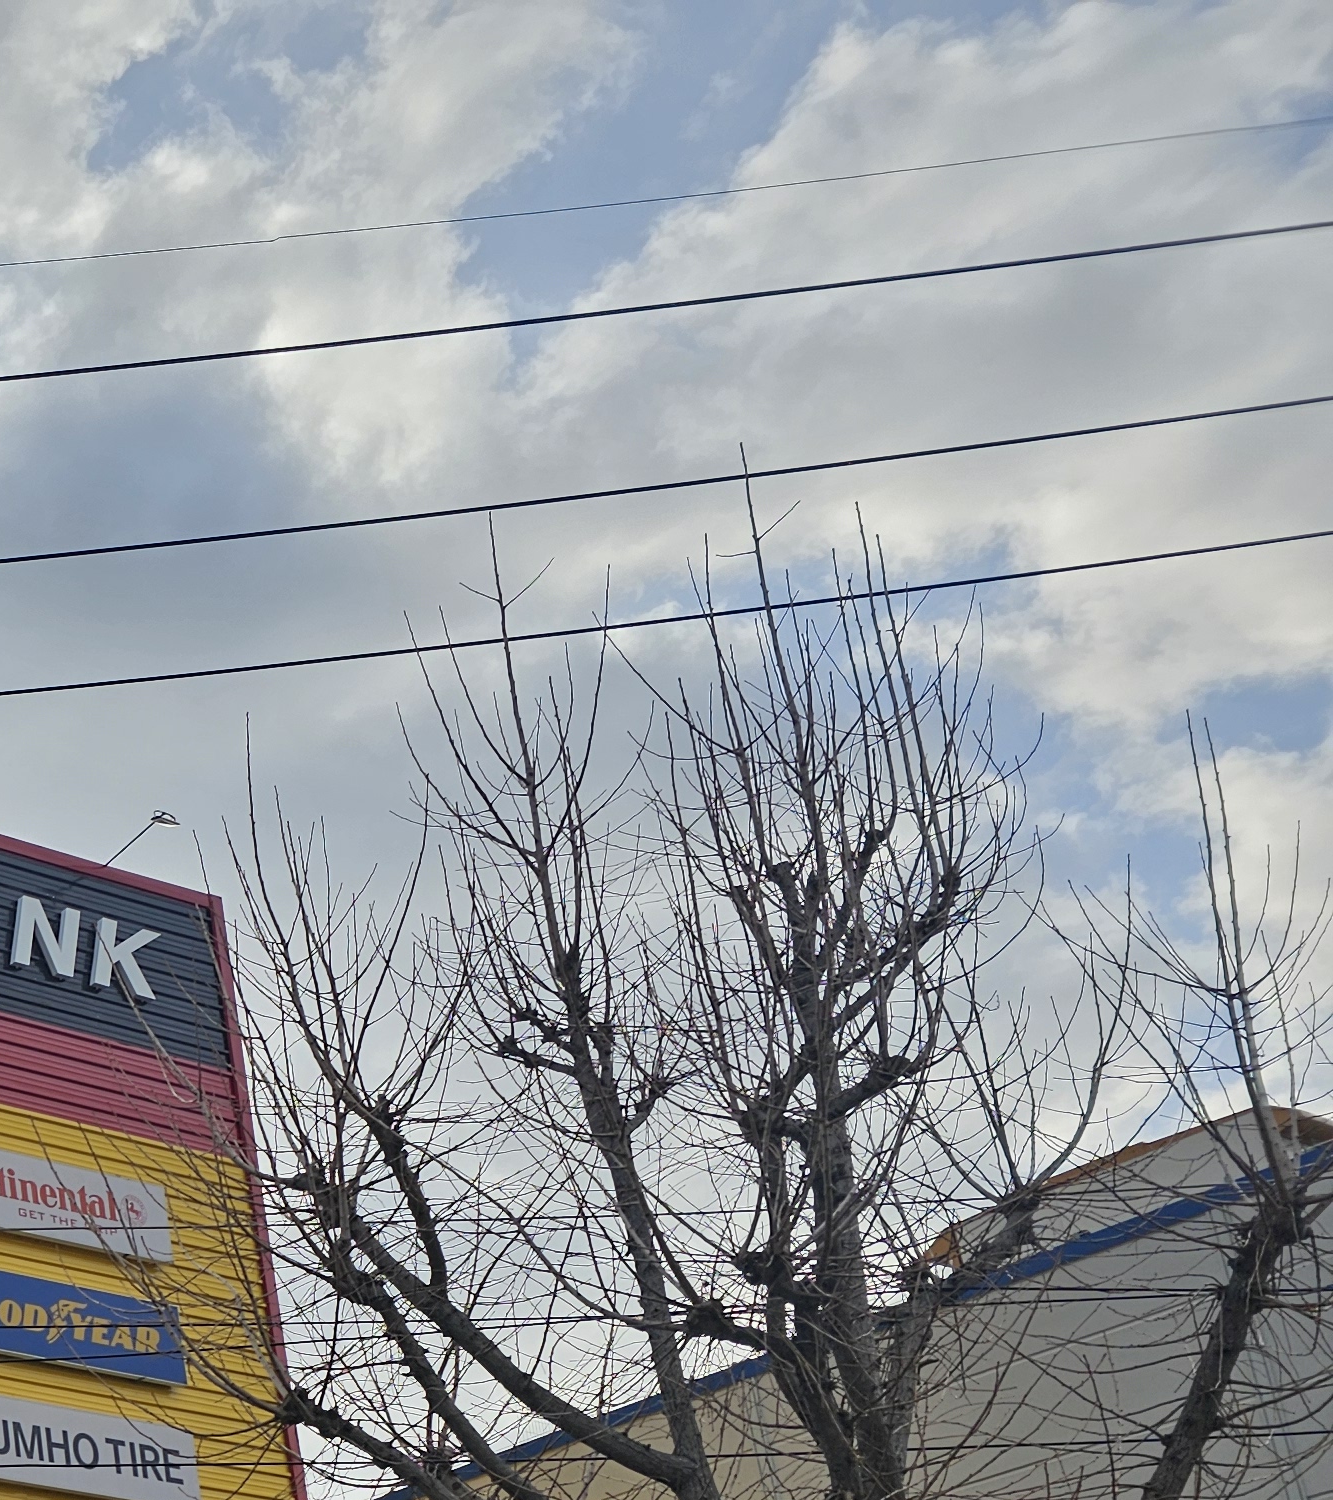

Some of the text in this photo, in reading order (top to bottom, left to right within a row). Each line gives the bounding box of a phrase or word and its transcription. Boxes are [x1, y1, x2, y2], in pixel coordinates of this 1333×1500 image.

[19, 1208, 77, 1226] GET THE
[105, 1437, 184, 1485] TIRE
